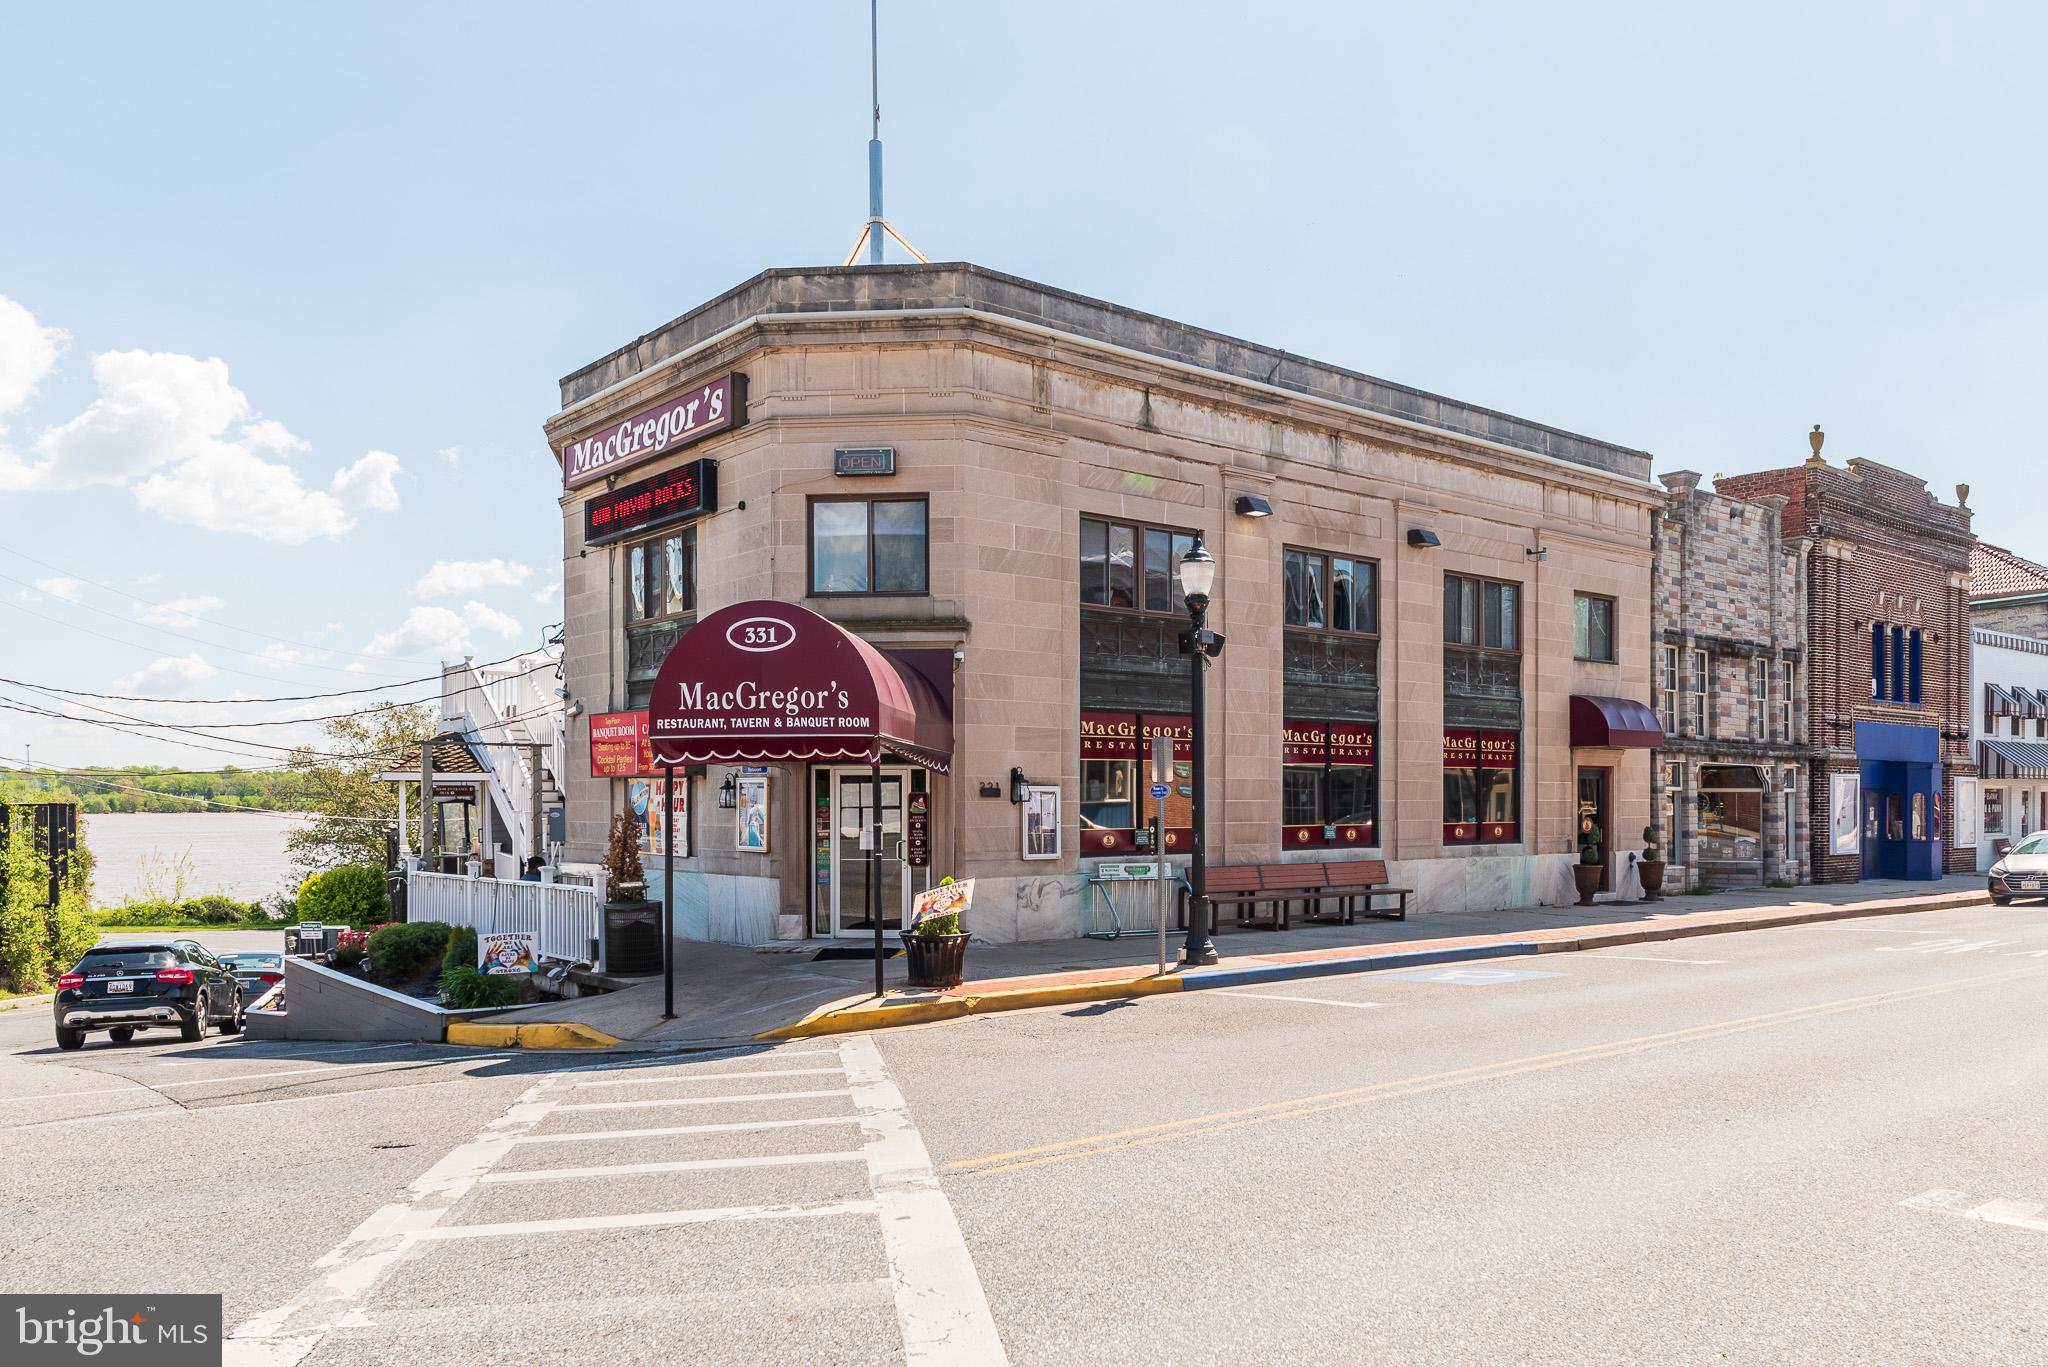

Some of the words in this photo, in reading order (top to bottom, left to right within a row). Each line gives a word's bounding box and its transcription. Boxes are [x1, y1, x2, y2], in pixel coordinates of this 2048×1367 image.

[571, 386, 723, 475] MacGregor's
[839, 456, 880, 468] OPEN
[591, 506, 612, 526] OUR
[613, 492, 652, 519] MAYOR
[654, 478, 692, 506] ROCKS
[745, 627, 777, 643] 331
[679, 680, 849, 715] MacGregor's
[657, 718, 727, 730] RESTAURANT,
[730, 717, 770, 728] TAVERN
[774, 717, 782, 727] &
[787, 717, 835, 728] BANQUET
[838, 717, 870, 727] ROOM
[1081, 721, 1192, 738] MacGregor's
[592, 727, 617, 739] BANQUET
[618, 725, 634, 736] ROOM
[1281, 729, 1372, 745] MacGregor's
[1084, 741, 1190, 751] RESTAUNT
[1442, 736, 1515, 751] MacGregor's
[1284, 747, 1369, 756] RESTAURANT
[1443, 752, 1513, 760] RESTAURANT
[656, 781, 685, 795] HPY
[661, 798, 685, 812] HUR
[484, 934, 532, 943] TOGETHER
